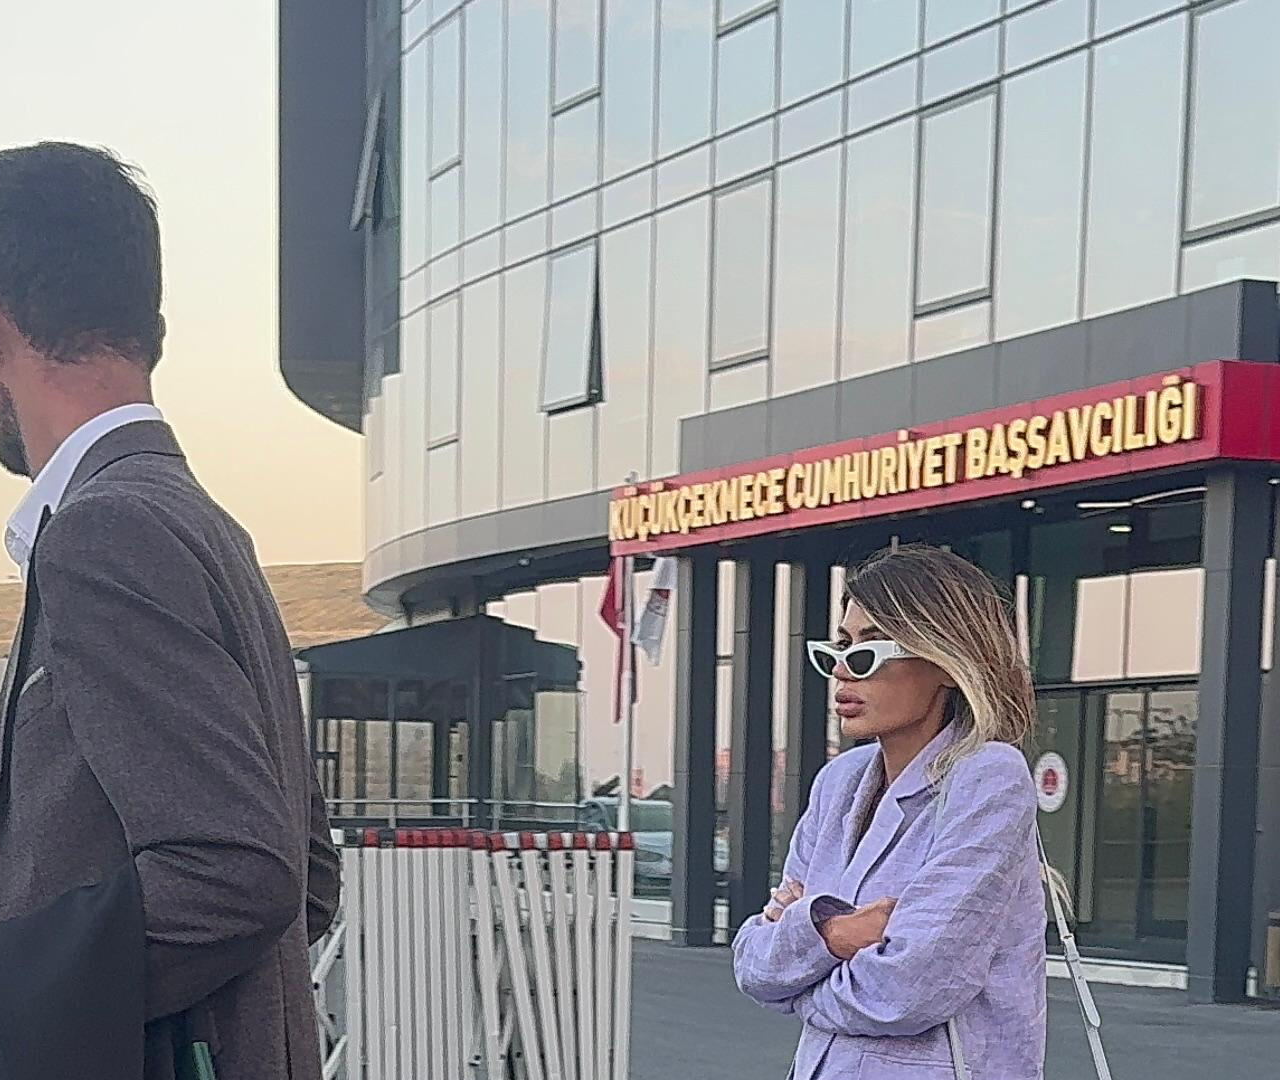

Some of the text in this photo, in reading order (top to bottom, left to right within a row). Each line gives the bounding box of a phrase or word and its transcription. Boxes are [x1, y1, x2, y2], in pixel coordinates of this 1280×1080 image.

[609, 374, 1198, 542] KÜÇÜKÇEKMECE CUMHURİYET BAŞSAVCILIĞI
